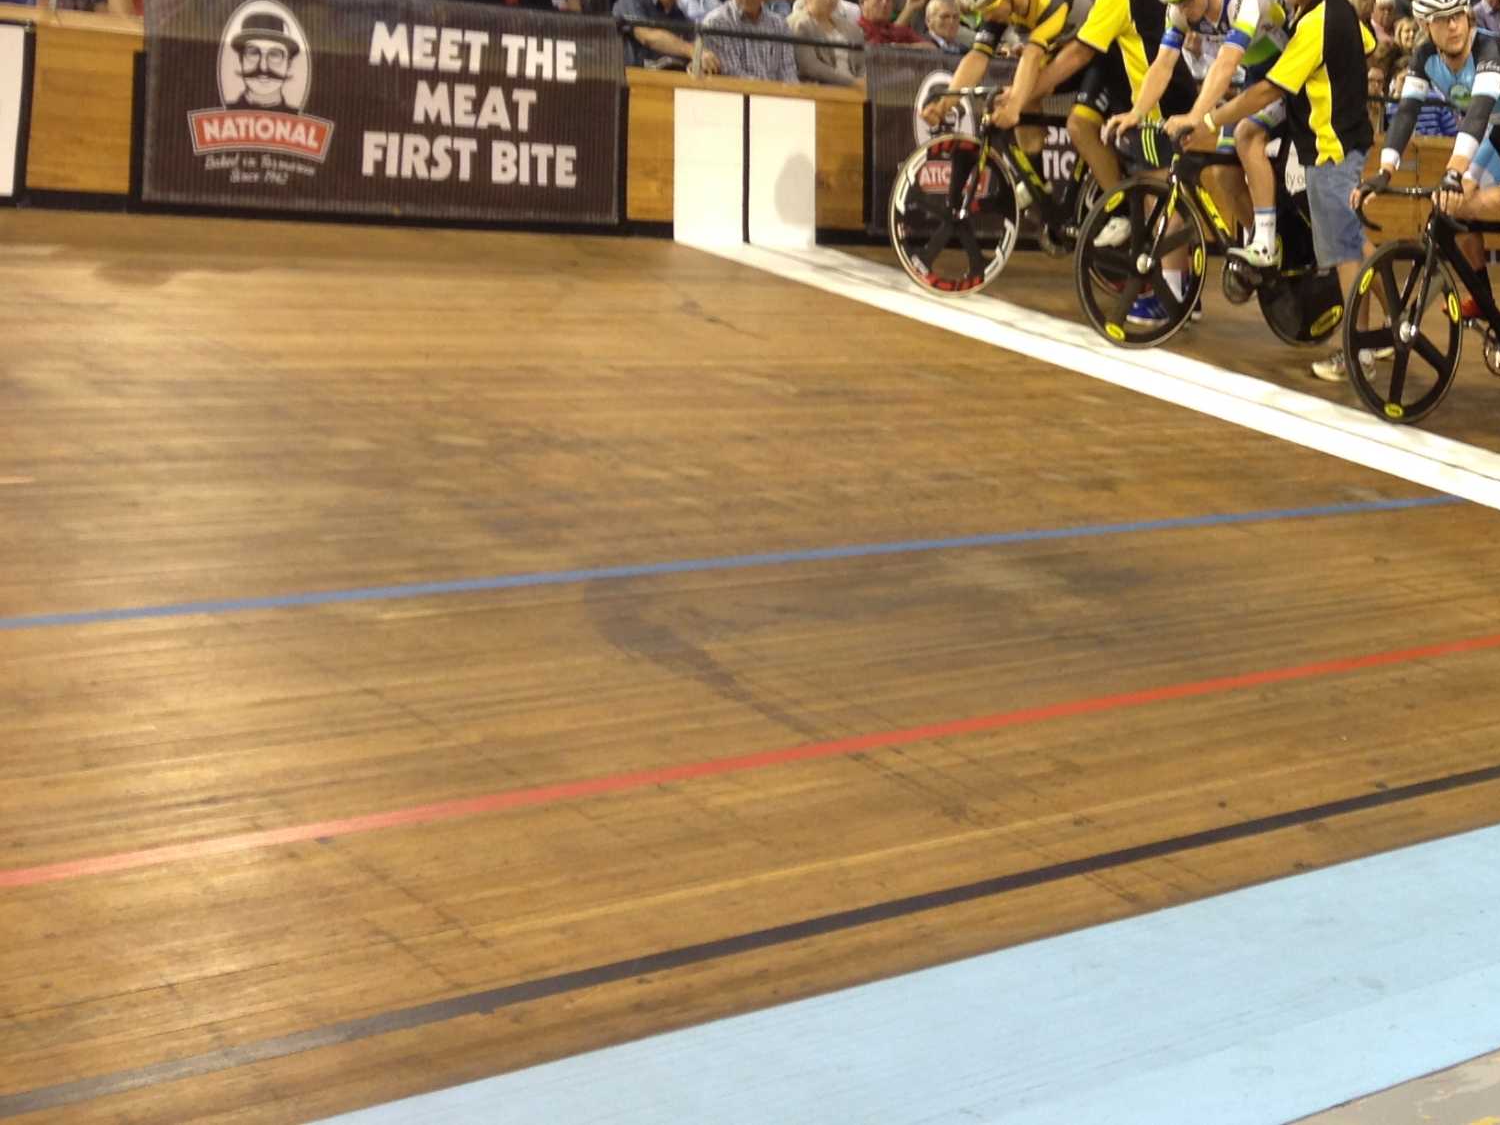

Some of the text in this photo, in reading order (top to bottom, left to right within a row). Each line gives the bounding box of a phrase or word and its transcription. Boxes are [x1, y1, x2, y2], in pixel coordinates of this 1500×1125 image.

[369, 21, 577, 83] MEET THE
[202, 116, 319, 148] NATIONAL
[413, 79, 537, 132] MEAT
[362, 131, 577, 189] FIRST BITE
